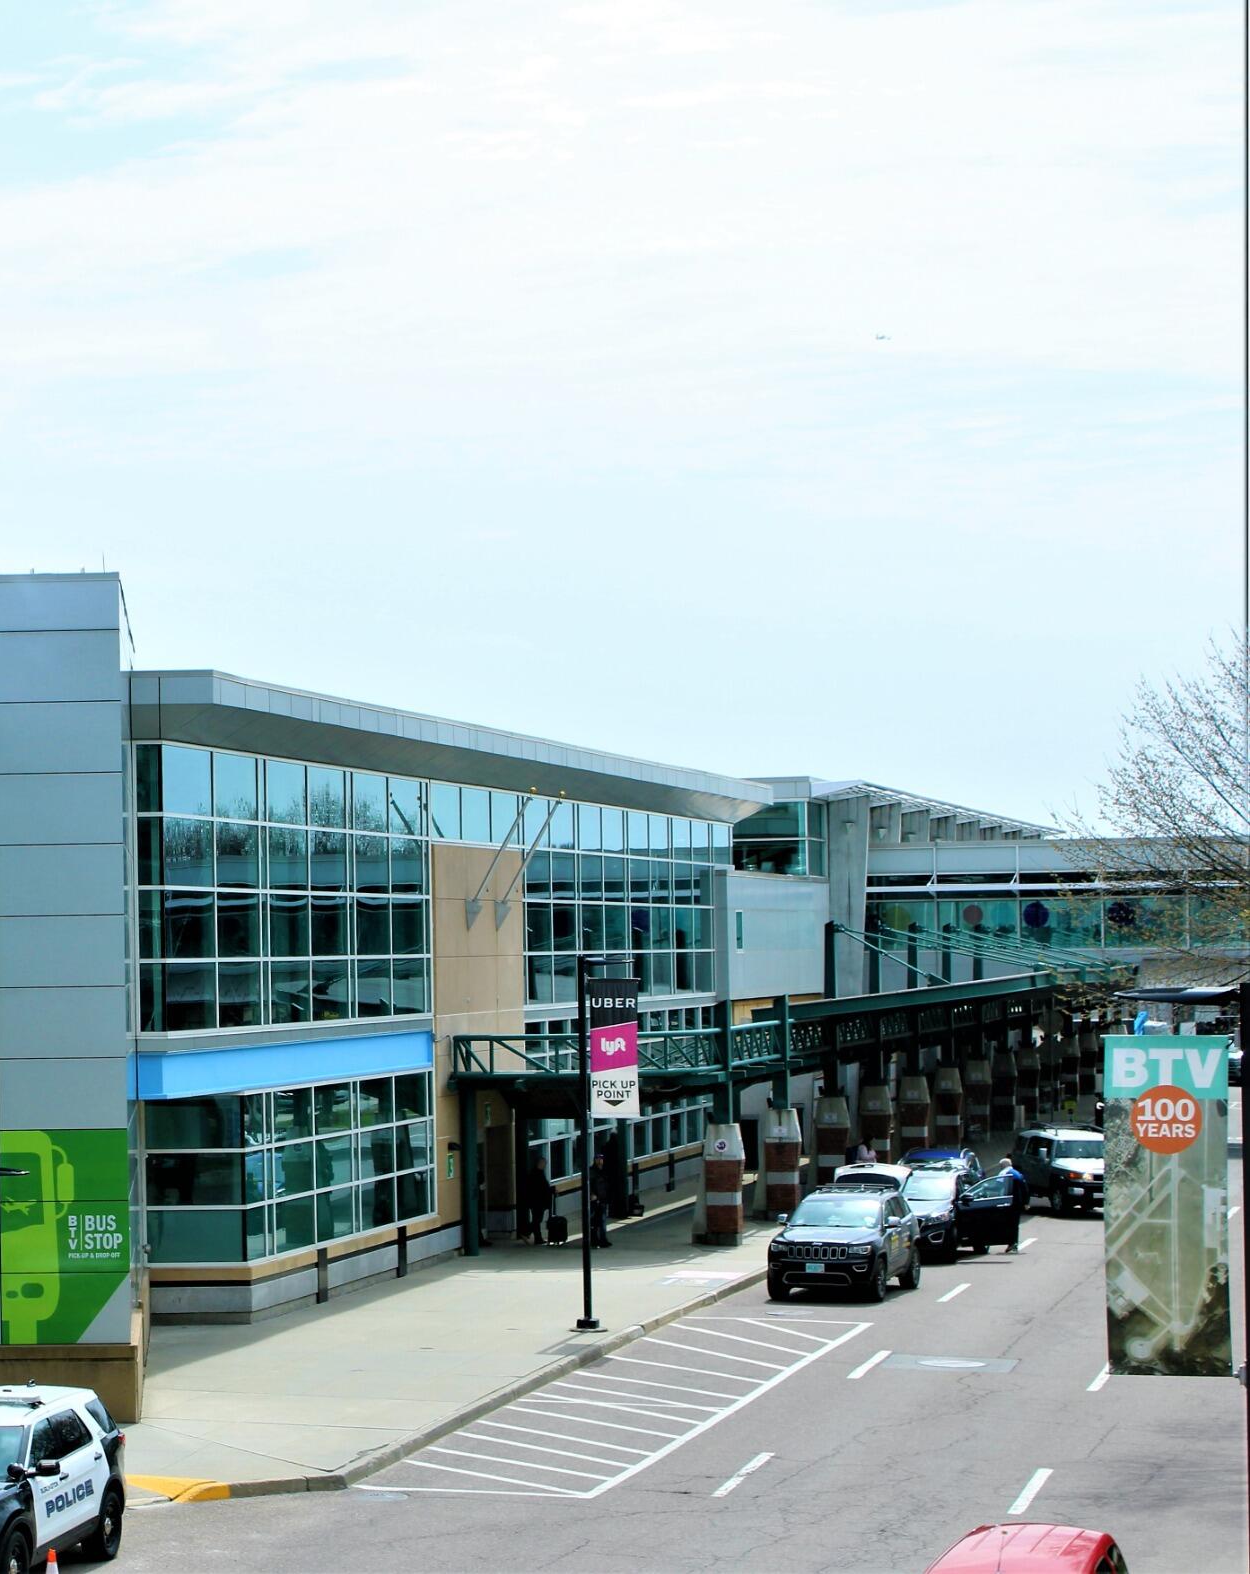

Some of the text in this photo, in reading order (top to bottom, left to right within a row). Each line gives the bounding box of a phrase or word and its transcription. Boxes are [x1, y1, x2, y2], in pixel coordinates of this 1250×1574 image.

[592, 998, 635, 1008] UBER
[1112, 1048, 1222, 1088] BTV
[1137, 1098, 1195, 1121] 100
[1136, 1123, 1196, 1138] YEARS
[84, 1215, 117, 1231] BUS
[84, 1233, 123, 1249] STOP
[45, 1478, 94, 1518] POLICE
